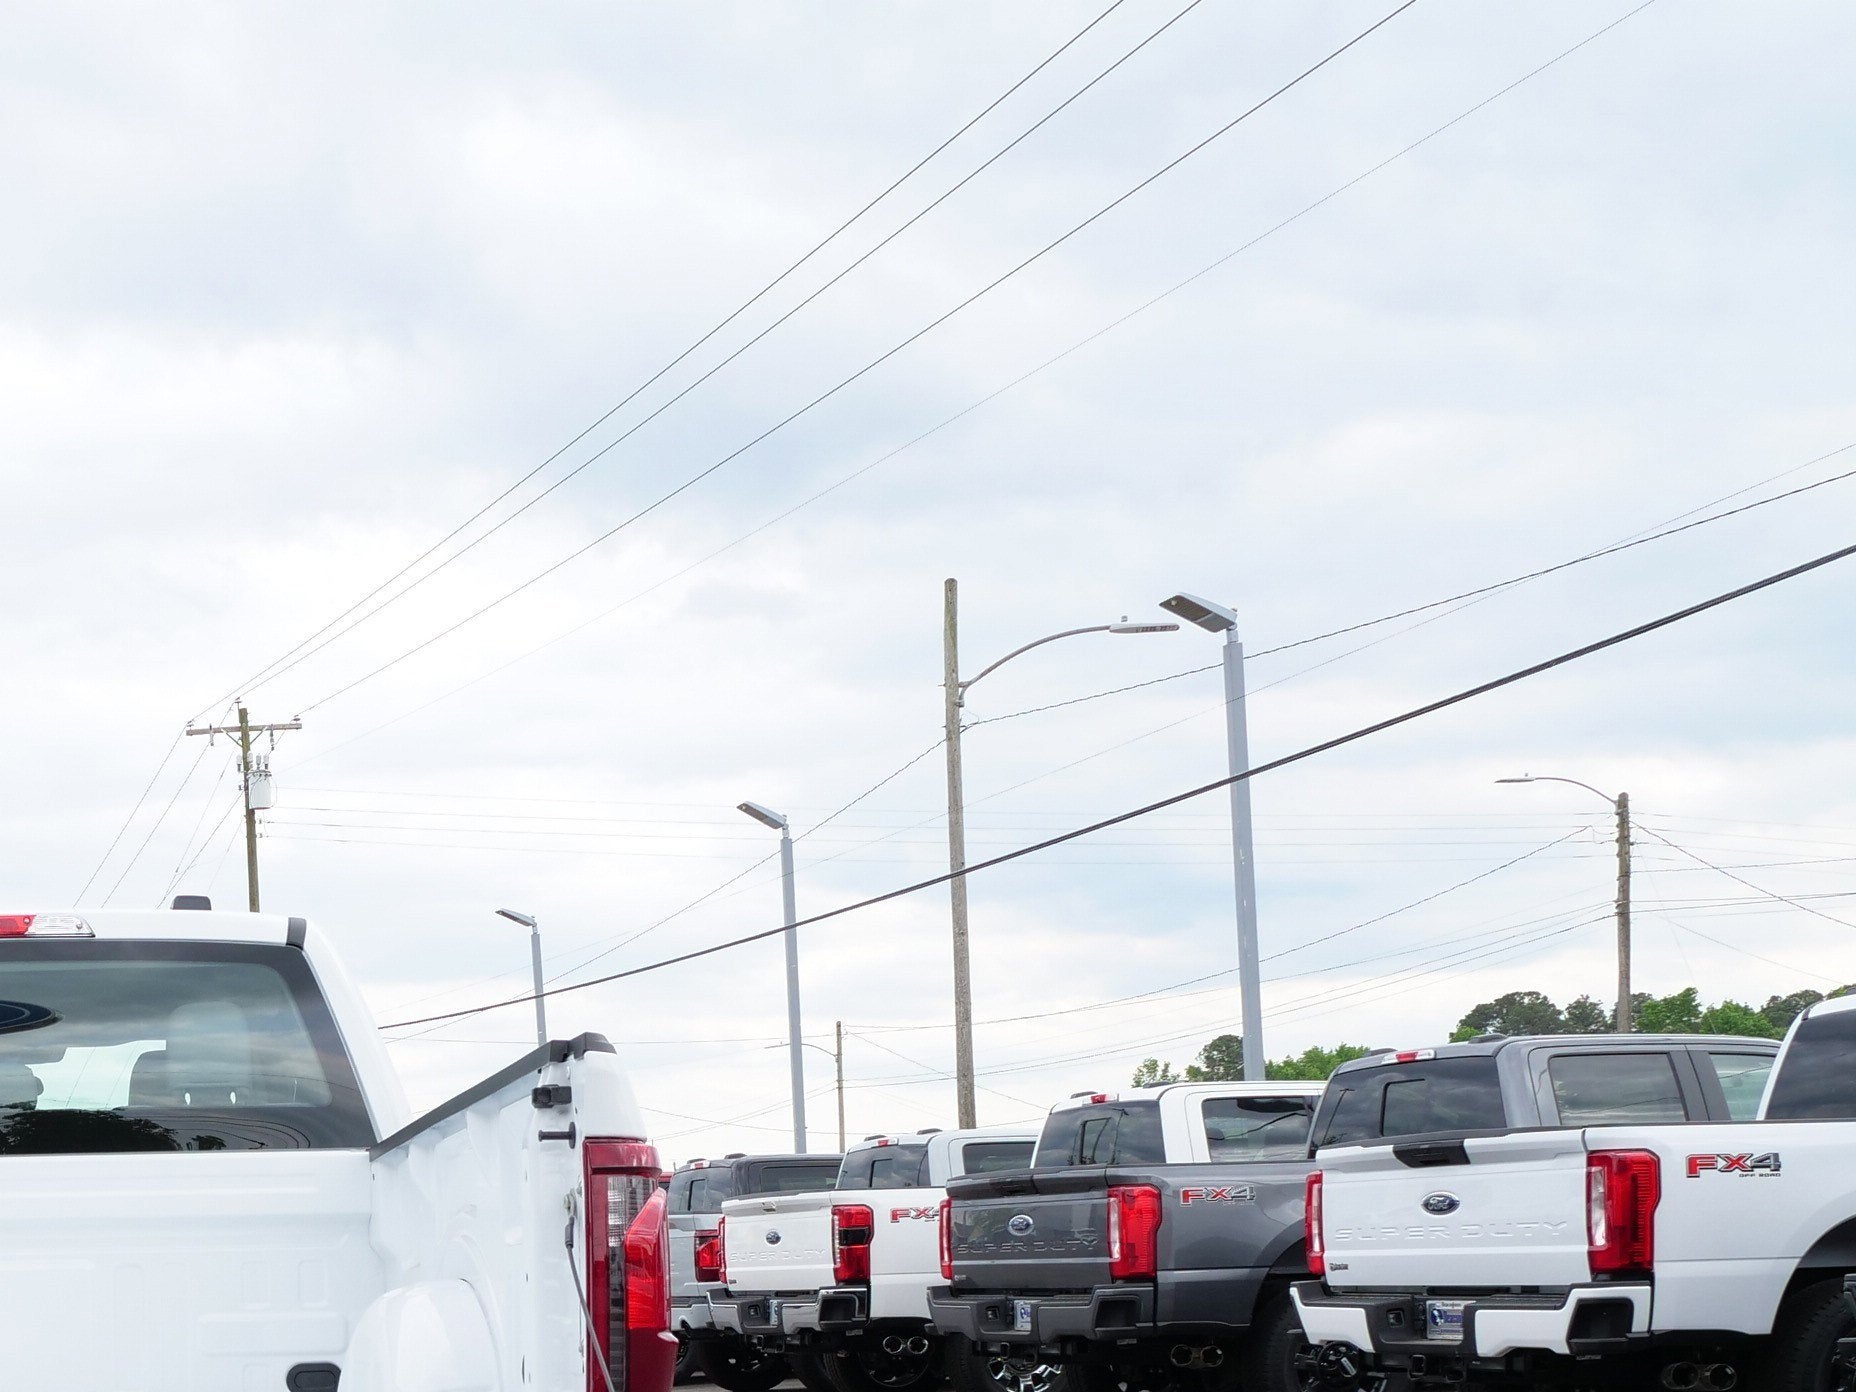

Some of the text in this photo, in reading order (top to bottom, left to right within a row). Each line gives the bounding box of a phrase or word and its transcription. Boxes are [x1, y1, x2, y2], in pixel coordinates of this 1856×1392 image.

[1686, 1153, 1781, 1178] FX4
[1180, 1186, 1255, 1206] FX4
[1335, 1221, 1568, 1241] SUPER DUTY
[728, 1252, 776, 1262] SUPER
[957, 1240, 1098, 1254] SUPER DUTY
